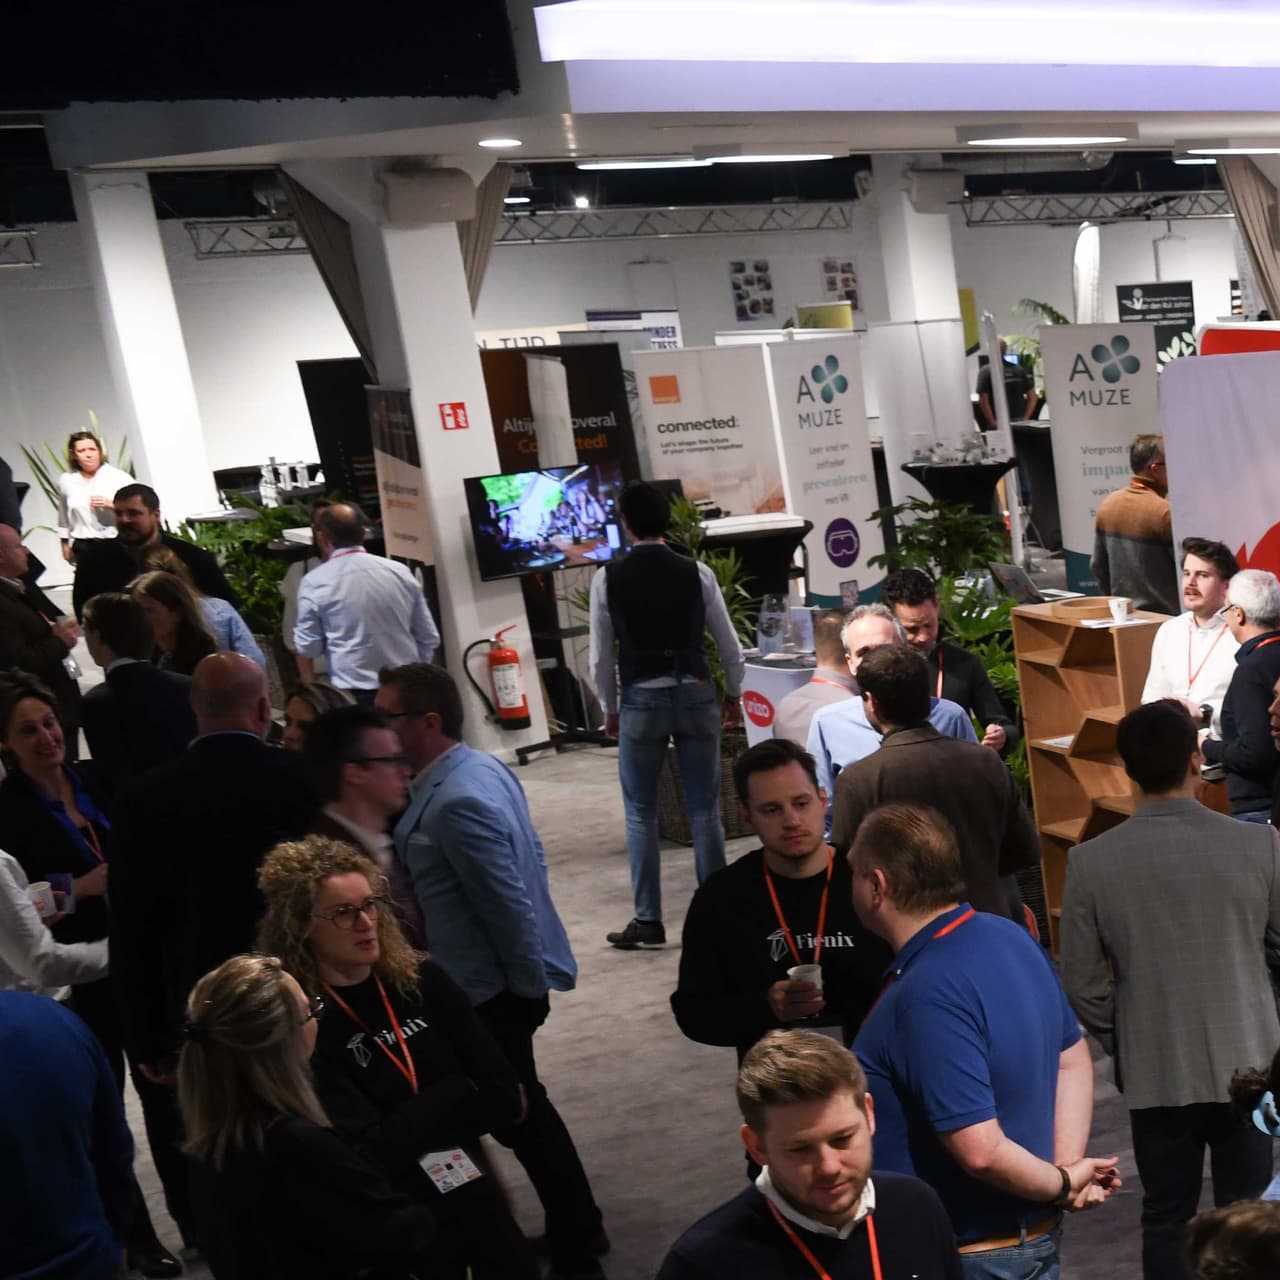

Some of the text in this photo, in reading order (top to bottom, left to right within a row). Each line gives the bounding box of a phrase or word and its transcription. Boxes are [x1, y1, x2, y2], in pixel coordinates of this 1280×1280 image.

[1069, 388, 1132, 407] MUZE
[798, 408, 844, 430] MUZE
[1080, 446, 1122, 456] Vergroot
